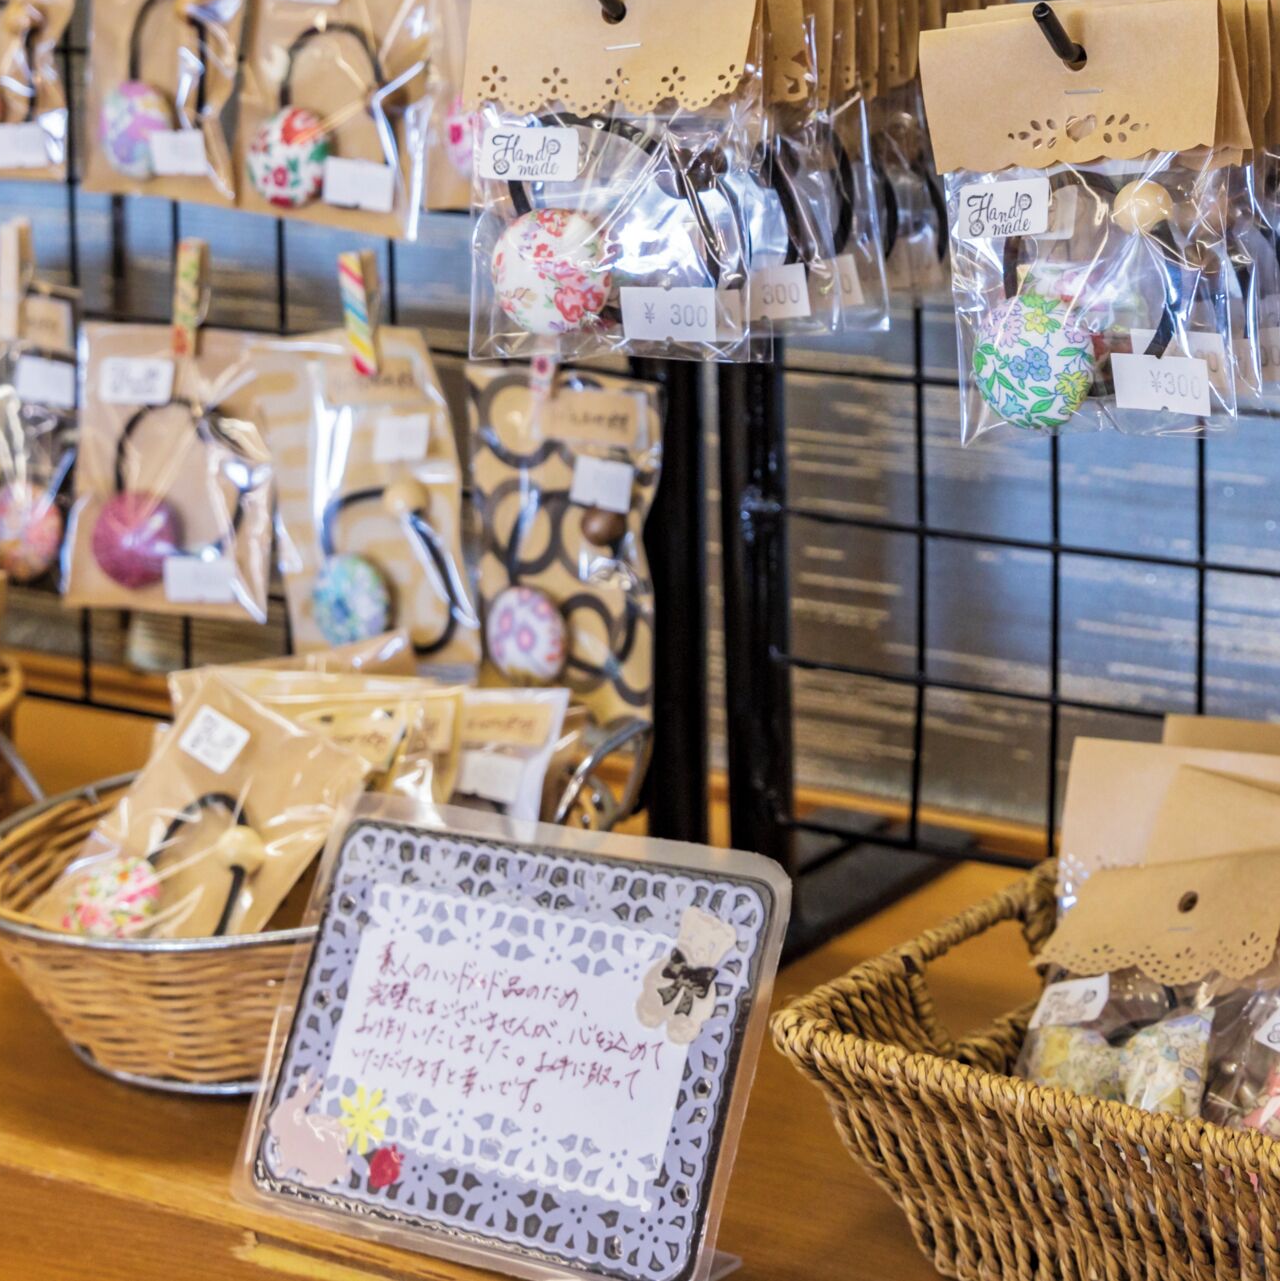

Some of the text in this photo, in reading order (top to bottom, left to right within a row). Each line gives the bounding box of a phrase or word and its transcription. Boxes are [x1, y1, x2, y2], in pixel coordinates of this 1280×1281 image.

[492, 134, 549, 165] Hand
[518, 157, 559, 176] made
[967, 193, 1020, 224] Hand
[992, 218, 1031, 236] made
[670, 303, 709, 328] 300
[1149, 370, 1202, 400] ¥300
